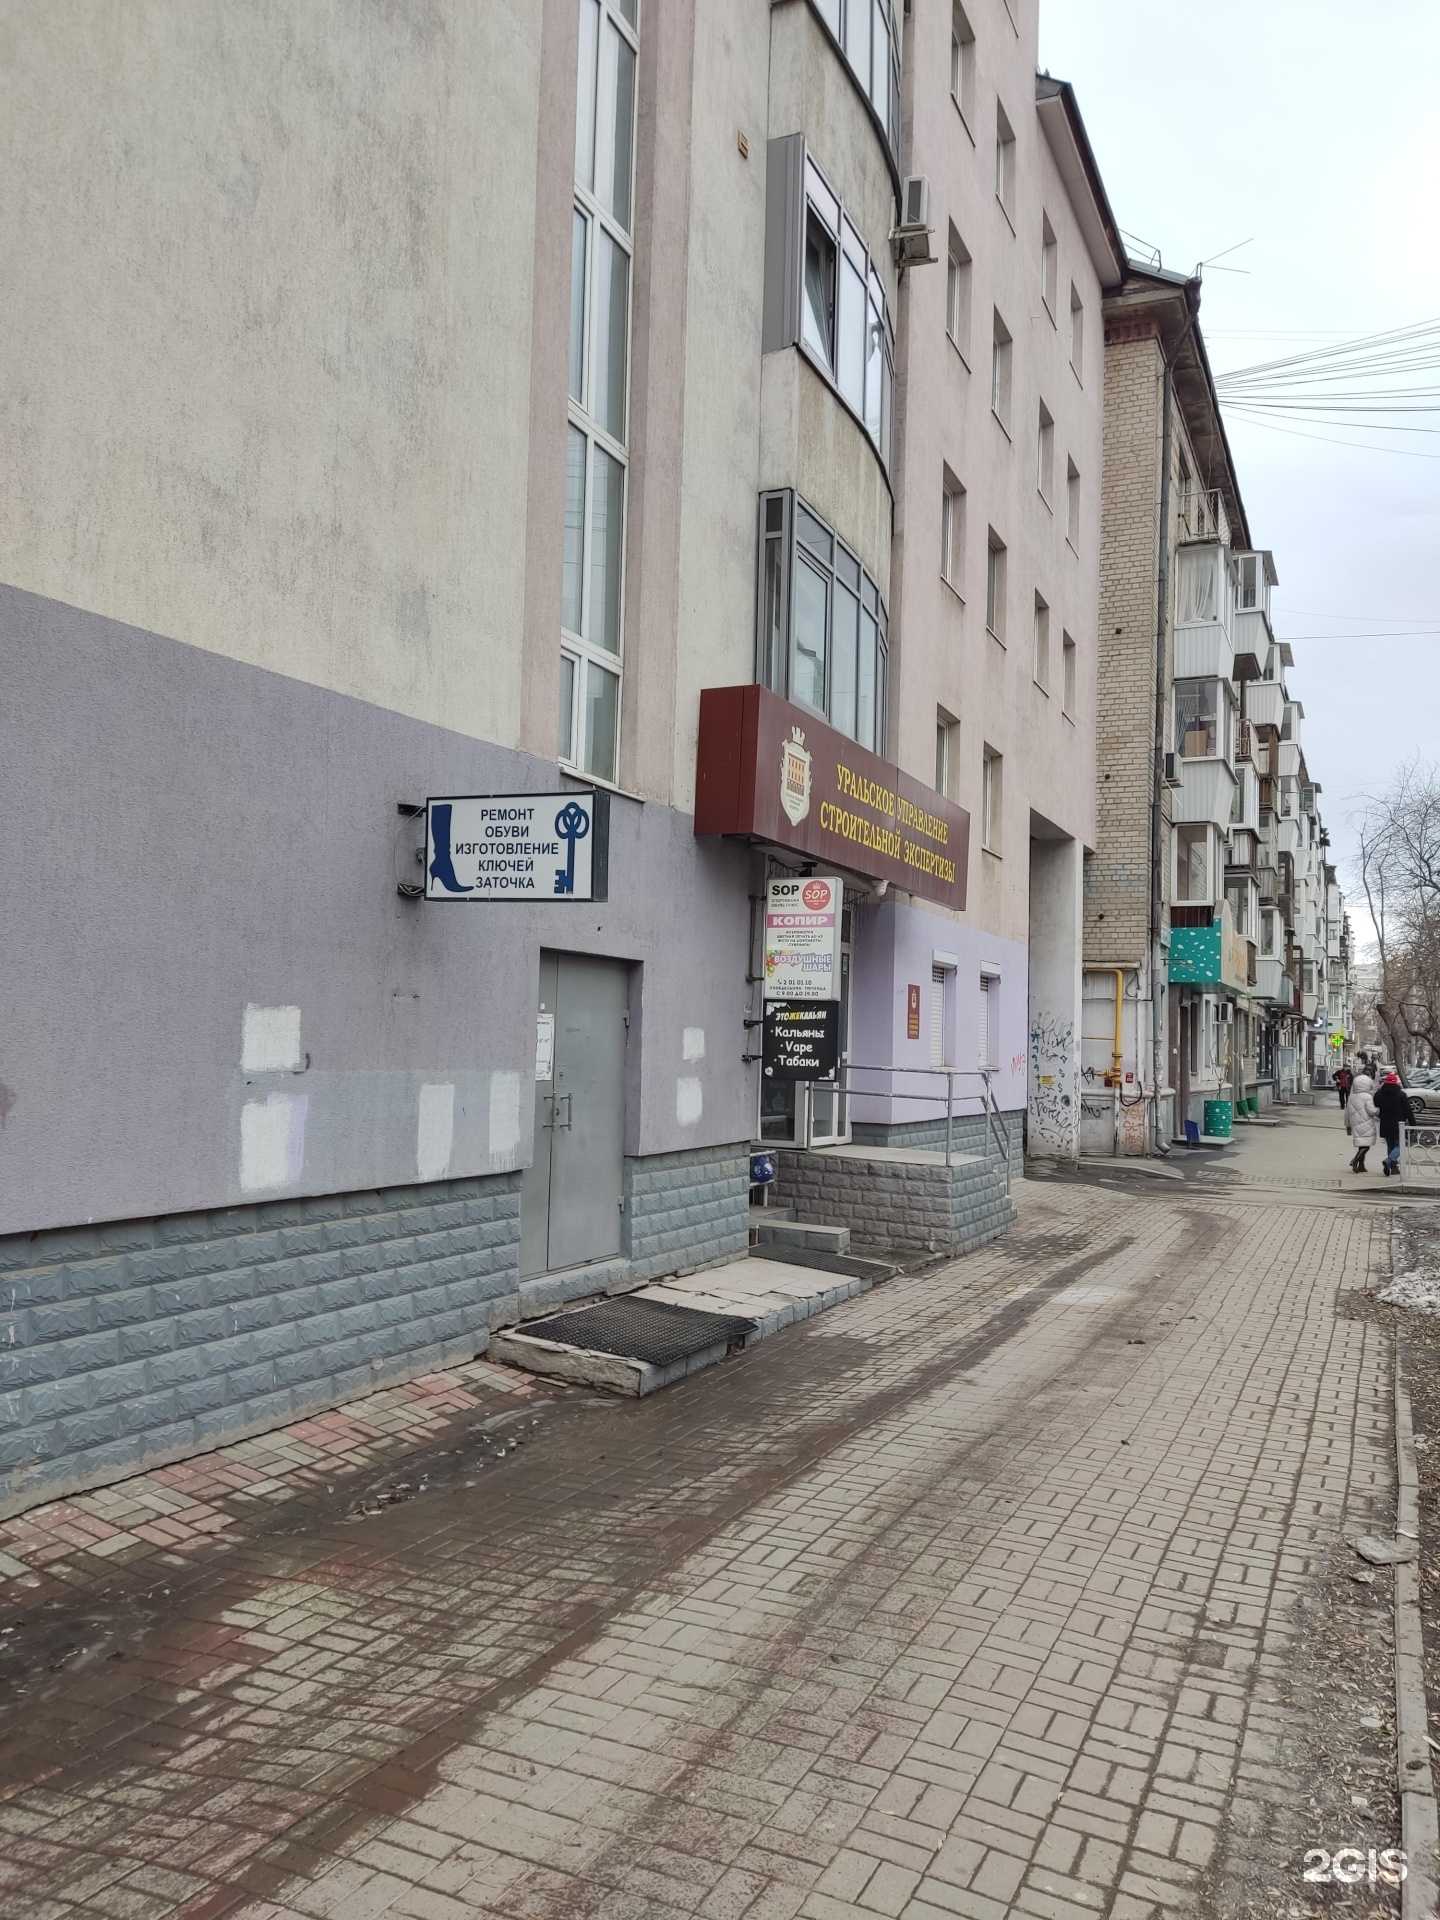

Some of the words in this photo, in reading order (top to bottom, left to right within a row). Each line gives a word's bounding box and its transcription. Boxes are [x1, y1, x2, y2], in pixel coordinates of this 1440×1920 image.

[836, 763, 895, 816] УРАЛЬСКОЕ
[897, 796, 949, 844] УПРАВЛЕНИЕ
[480, 808, 535, 821] РЕМОНТ
[485, 825, 529, 838] ОБУВИ
[455, 842, 559, 855] ИЗГОТОВЛЕНИЕ
[820, 801, 901, 859] СТРОИТЕЛЬНОЙ
[903, 840, 956, 883] ЭКСПЕРТИЗЫ
[478, 857, 534, 872] КЛЮЧЕЙ
[475, 876, 535, 889] ЗАТОЧКА
[771, 884, 800, 896] SOP
[803, 889, 828, 900] SOP
[772, 916, 828, 926] КОПИР
[803, 963, 832, 972] ШАРЫ
[775, 1026, 825, 1038] Кальяны
[785, 1040, 813, 1055] Vape
[778, 1055, 820, 1067] Табаки
